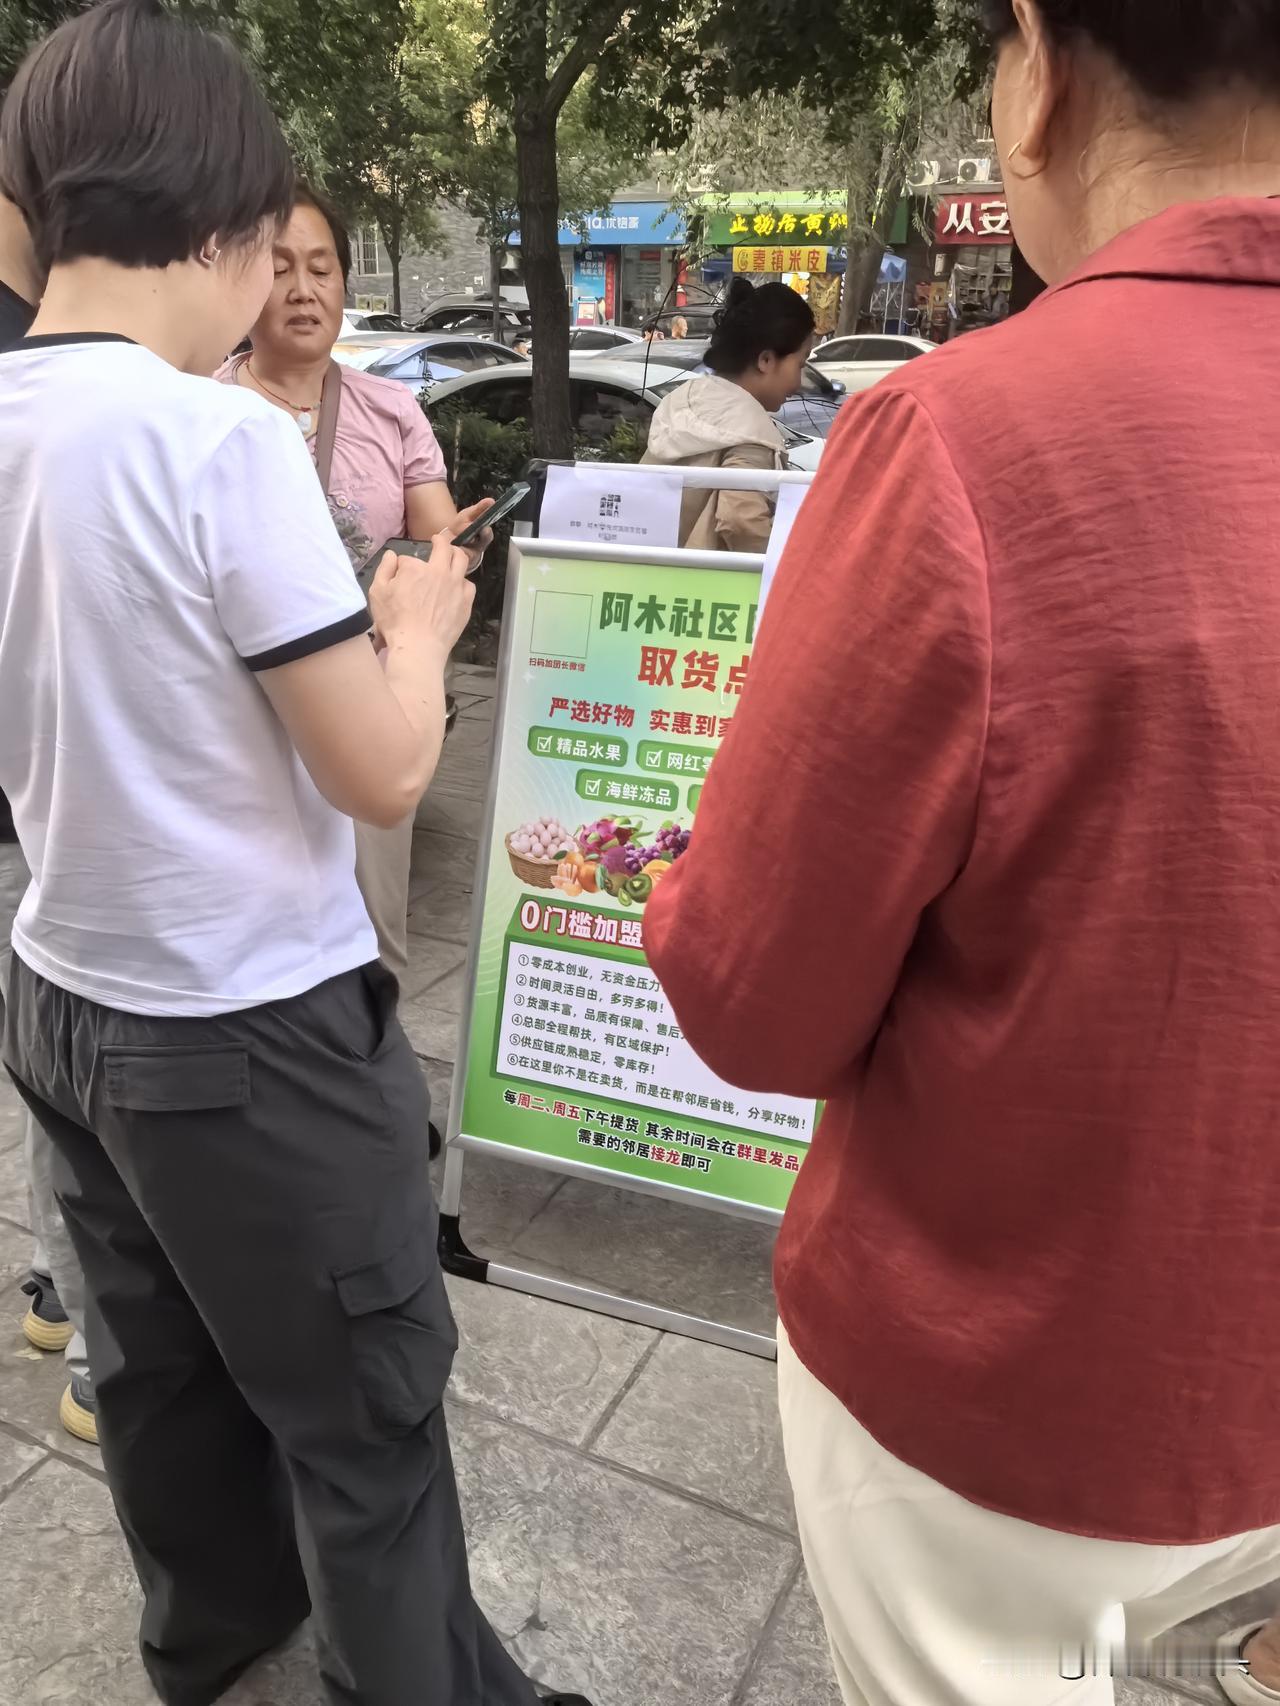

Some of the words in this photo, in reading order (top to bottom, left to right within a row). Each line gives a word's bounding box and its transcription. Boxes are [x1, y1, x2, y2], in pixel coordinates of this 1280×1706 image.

[942, 200, 1010, 236] 从安
[548, 696, 635, 728] 严选好物
[556, 737, 621, 761] 精品水果
[605, 780, 672, 806] 海鲜冻品
[519, 898, 644, 948] 0门槛加盟
[513, 993, 685, 1040] ③货源丰富，品质有保障、售后
[503, 1088, 640, 1134] 每周二、周五下午提货
[577, 1128, 712, 1173] 需要的邻居接龙即可
